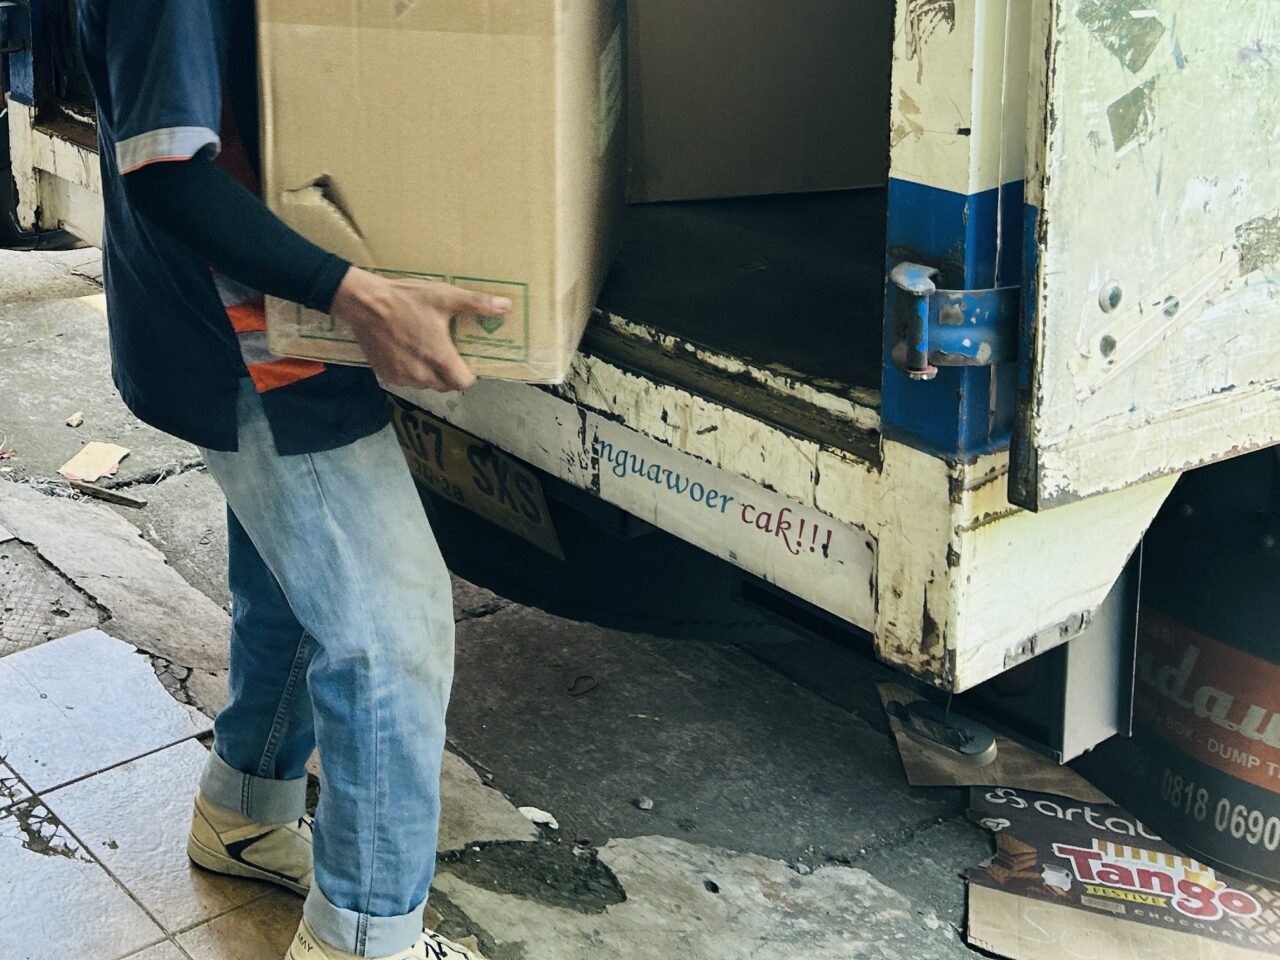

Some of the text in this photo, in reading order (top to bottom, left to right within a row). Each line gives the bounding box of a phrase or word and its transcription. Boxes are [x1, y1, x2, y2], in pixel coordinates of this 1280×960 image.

[599, 440, 833, 559] nguawoer cak!!!
[1207, 737, 1262, 769] DUMP
[1163, 768, 1280, 851] 0818 0690
[1052, 841, 1262, 921] Tango
[1091, 886, 1159, 905] FESTIVE
